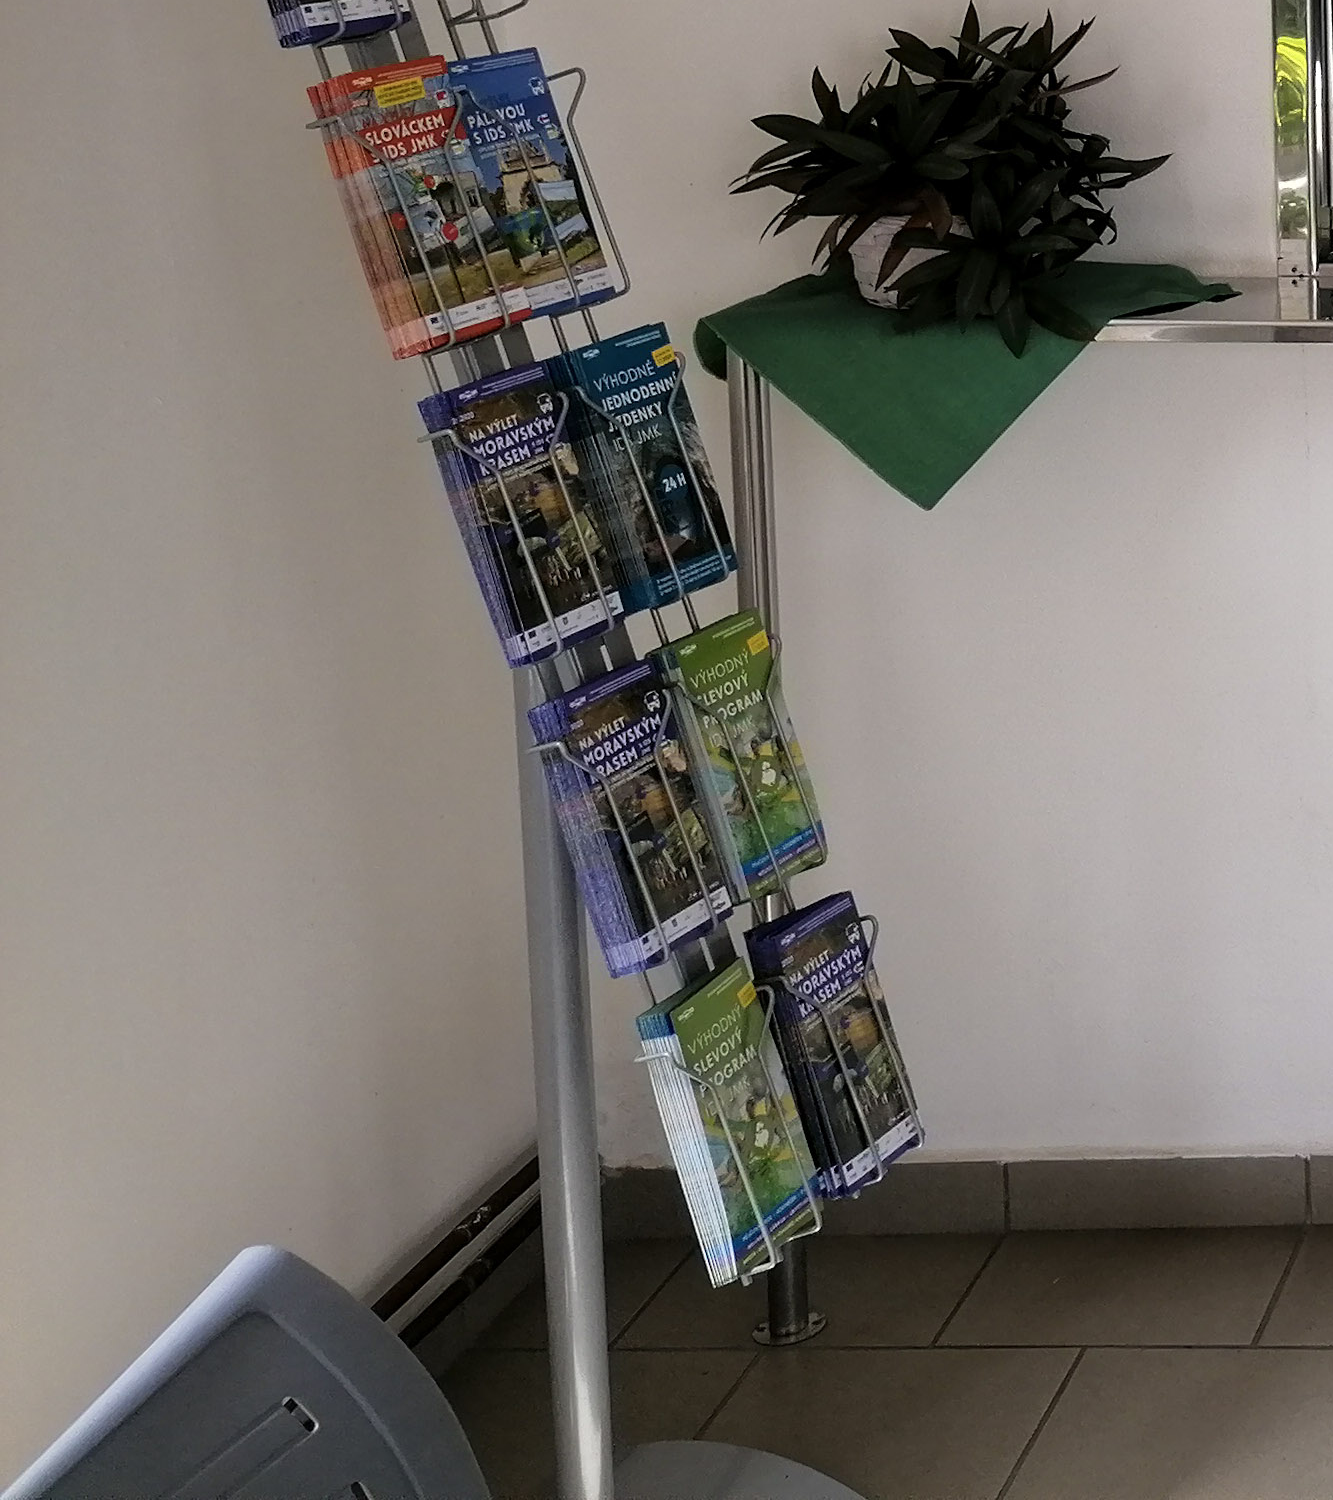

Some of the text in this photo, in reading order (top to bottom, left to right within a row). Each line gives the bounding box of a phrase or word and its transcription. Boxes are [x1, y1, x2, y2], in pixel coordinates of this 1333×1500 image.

[365, 113, 445, 146] SLOVÁCKEM
[467, 103, 526, 129] PÁLVOU
[382, 134, 438, 160] IDS JMK
[484, 125, 506, 142] IDS
[593, 360, 656, 393] VÝHODNÉ
[469, 414, 518, 443] NA VÝLET
[637, 423, 662, 444] JMK
[662, 472, 687, 493] 24 H
[690, 648, 749, 688] VÝHODNÝ
[697, 669, 749, 706] LEVOVÝ
[579, 716, 626, 752] NA VÝLET
[583, 713, 661, 766] MORAVSKÝM
[789, 949, 831, 988] NA VÝLET
[687, 1003, 742, 1055] VÝHODNÝ
[693, 1027, 743, 1077] SLEVOVÝ
